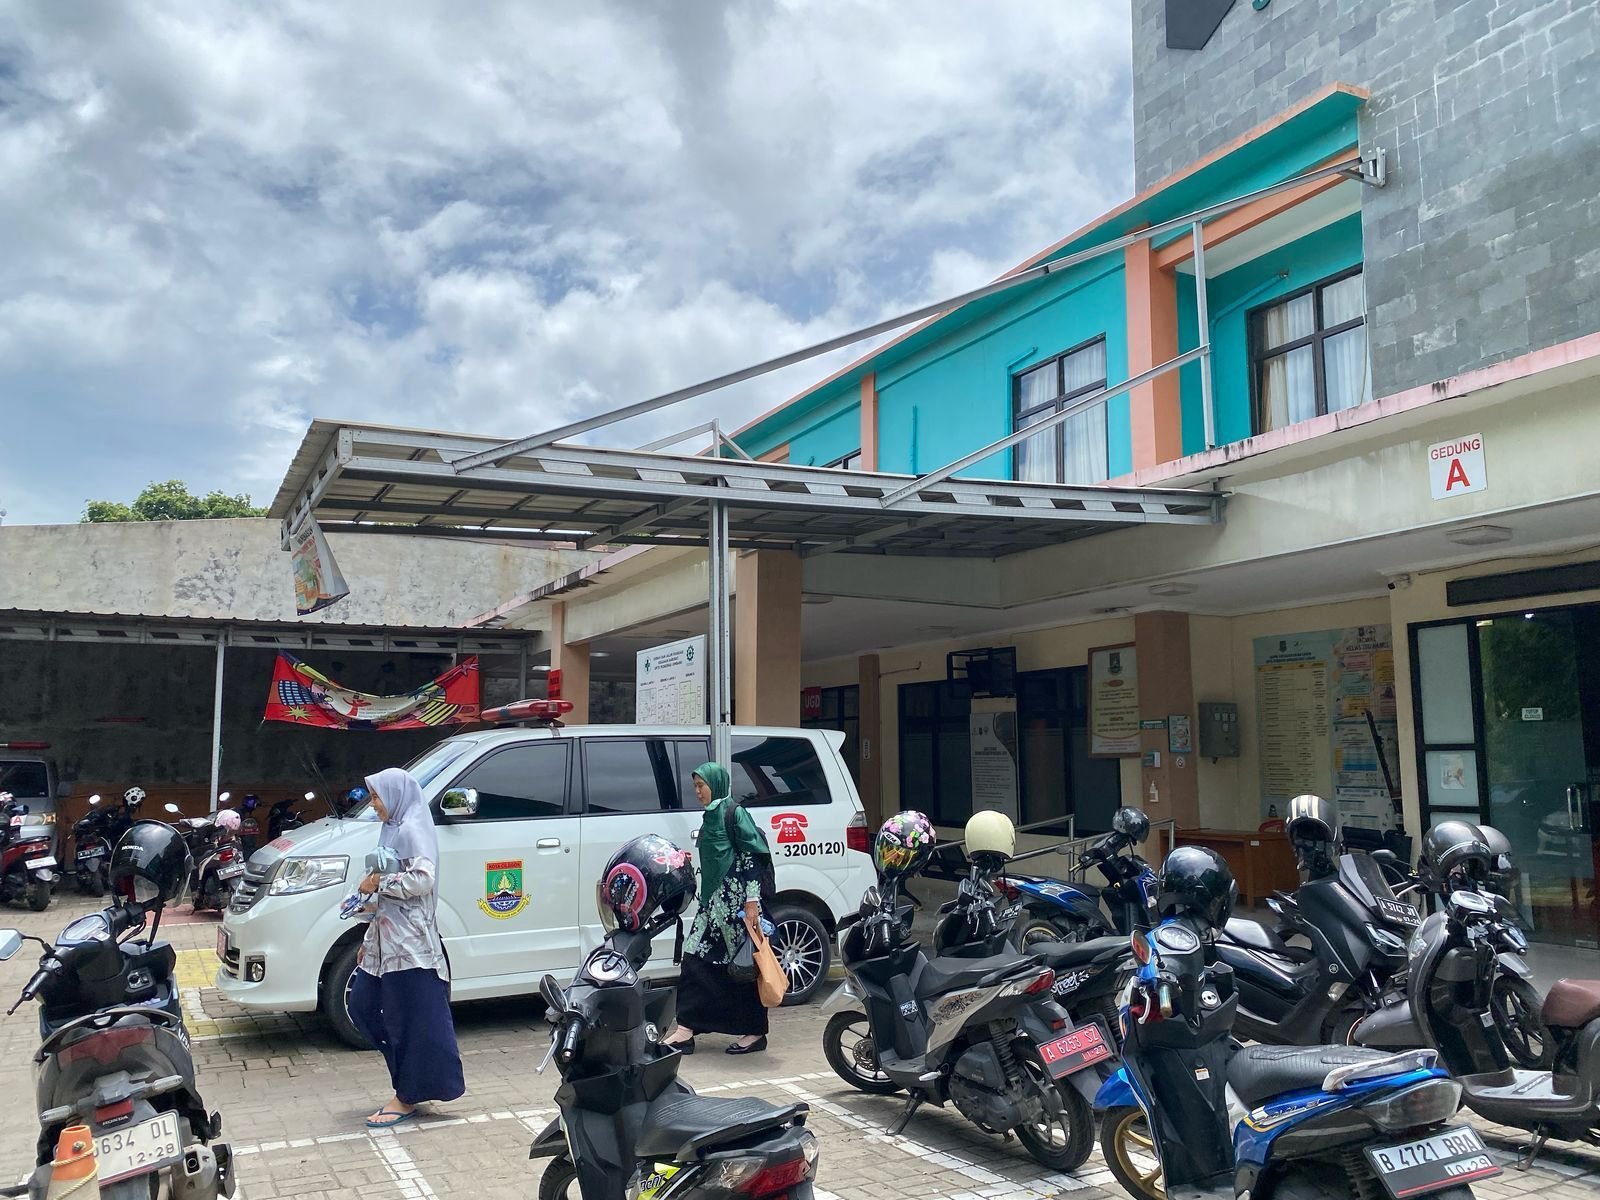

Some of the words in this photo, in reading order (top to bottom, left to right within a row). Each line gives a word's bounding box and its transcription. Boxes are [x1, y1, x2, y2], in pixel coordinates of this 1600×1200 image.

[1430, 438, 1481, 460] GEDUNG
[1446, 458, 1471, 491] A
[804, 695, 820, 708] UGD
[784, 842, 845, 857] 3200120)
[1046, 1047, 1055, 1060] A
[1057, 1036, 1082, 1054] 6253
[1084, 1028, 1099, 1043] SZ
[102, 1115, 129, 1126] HONDA
[150, 1119, 172, 1140] DL
[1379, 1153, 1396, 1171] B
[1399, 1142, 1441, 1166] 4721
[1442, 1133, 1478, 1156] BBA
